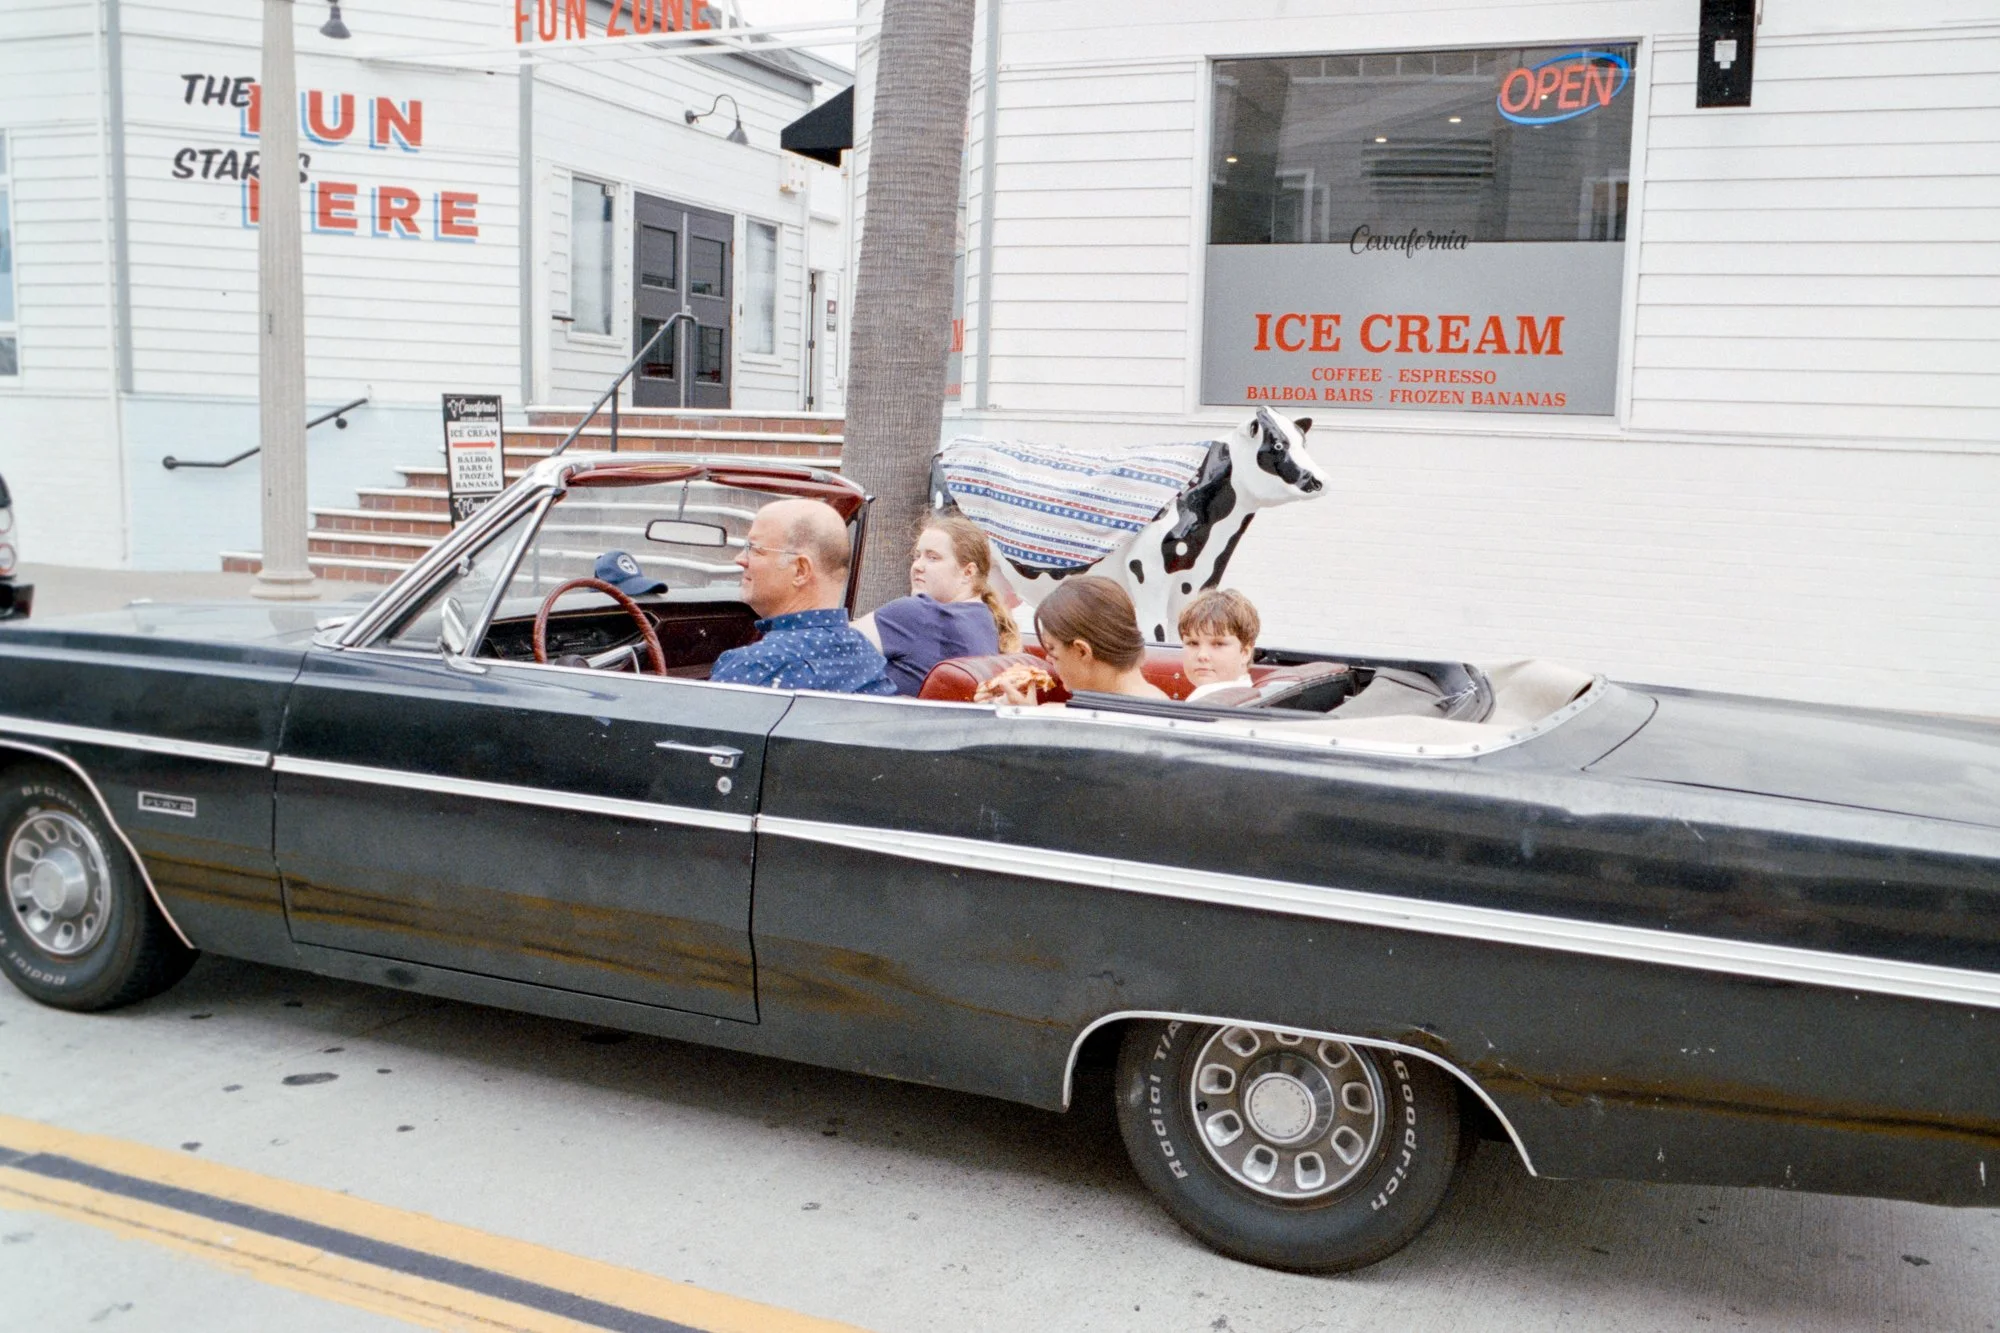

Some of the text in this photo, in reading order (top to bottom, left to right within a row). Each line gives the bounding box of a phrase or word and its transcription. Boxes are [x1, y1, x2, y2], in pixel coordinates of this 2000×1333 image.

[515, 0, 711, 43] FUN ZONE
[181, 74, 255, 107] THE
[1500, 62, 1617, 114] OPEN
[1350, 224, 1469, 259] Cowafornia
[1254, 313, 1566, 355] ICE CREAM
[1312, 368, 1383, 383] COFFEE
[1399, 368, 1497, 384] ESPRESSO
[1247, 386, 1318, 401] BALBOA
[1324, 388, 1374, 402] BARS
[1390, 389, 1465, 405] FROZEN
[1471, 391, 1567, 407] BANANAS
[450, 429, 498, 438] ICE CREAM
[459, 472, 495, 480] FROZEN
[1149, 1073, 1189, 1179] Radial
